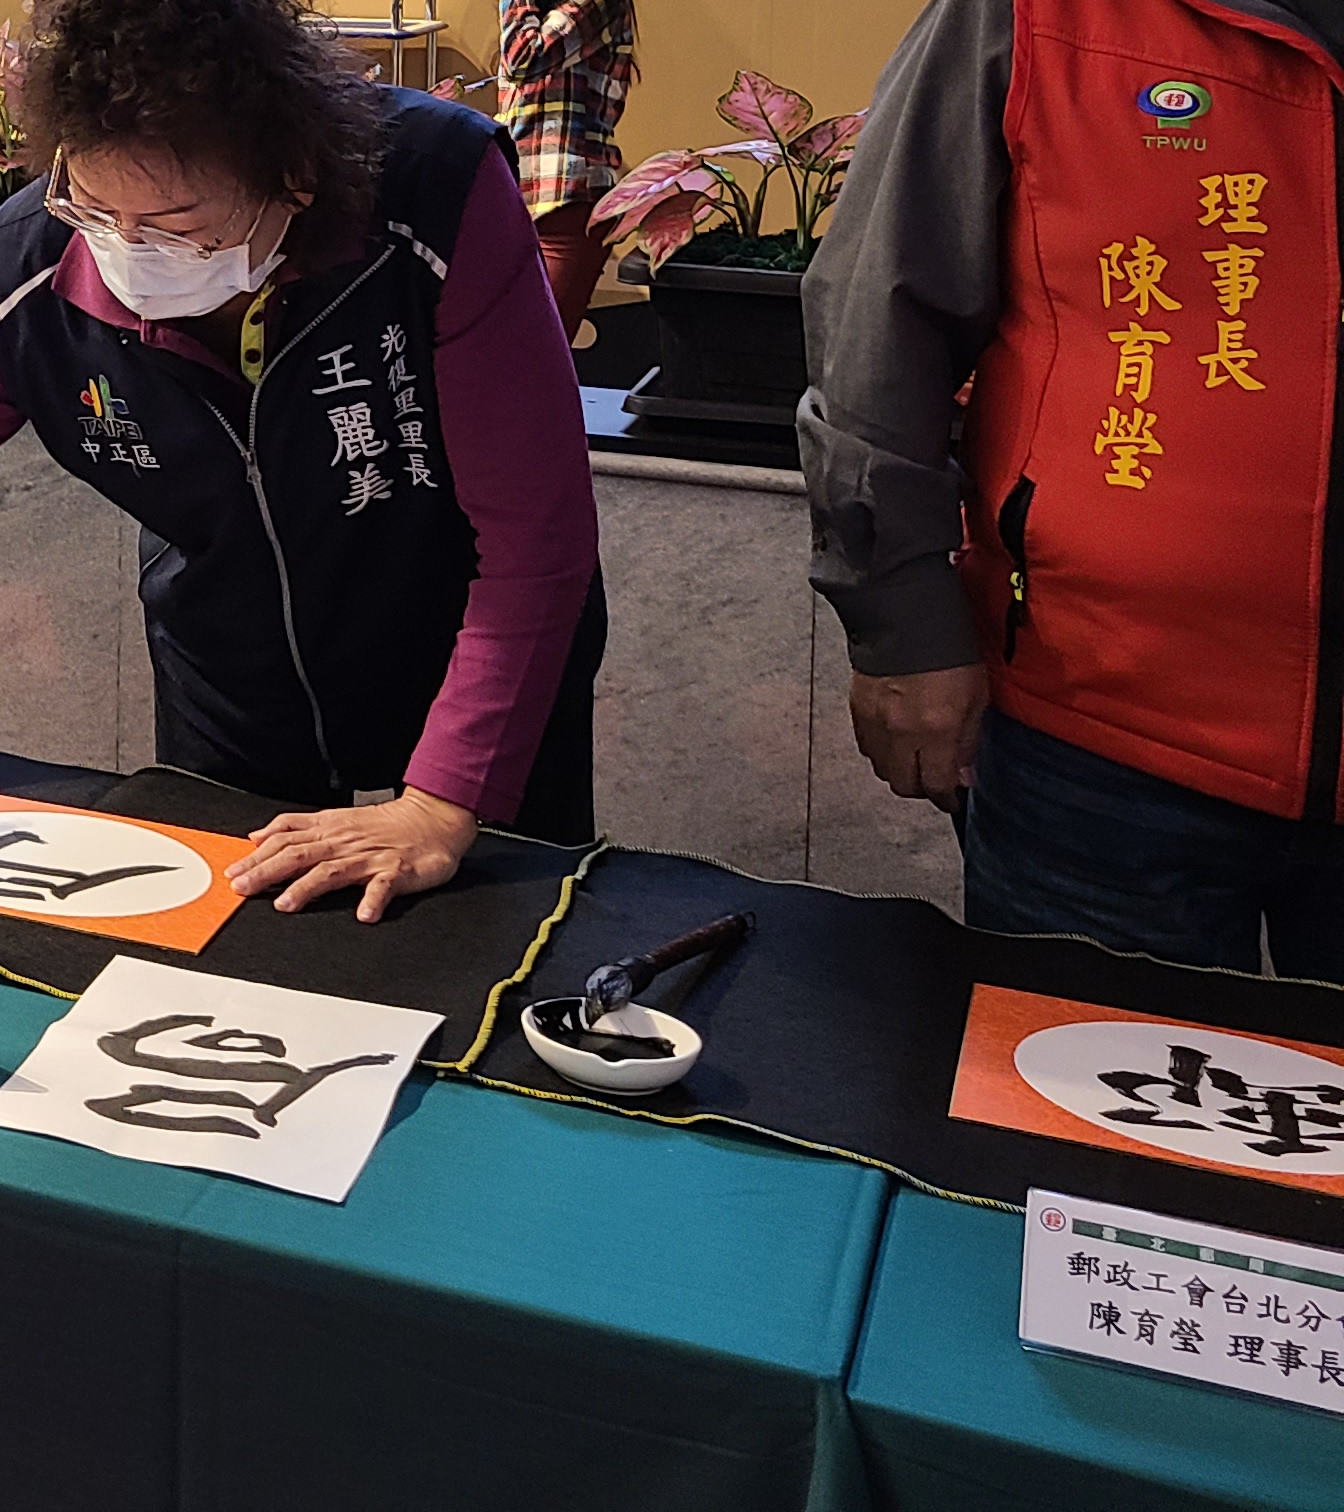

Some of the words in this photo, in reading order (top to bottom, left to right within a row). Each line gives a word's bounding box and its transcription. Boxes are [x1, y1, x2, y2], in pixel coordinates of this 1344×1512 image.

[1141, 136, 1207, 152] TPWU
[1198, 172, 1269, 391] 理事長
[380, 324, 439, 488] 光復里里長
[1095, 235, 1183, 490] 陳育瑩
[77, 417, 143, 440] TAIPEI
[80, 437, 160, 469] 中正區
[312, 344, 395, 517] 王麗美
[1066, 1250, 1344, 1333] 郵政工會台北分
[1087, 1300, 1206, 1356] 陳育瑩
[1226, 1334, 1344, 1388] 理事長
